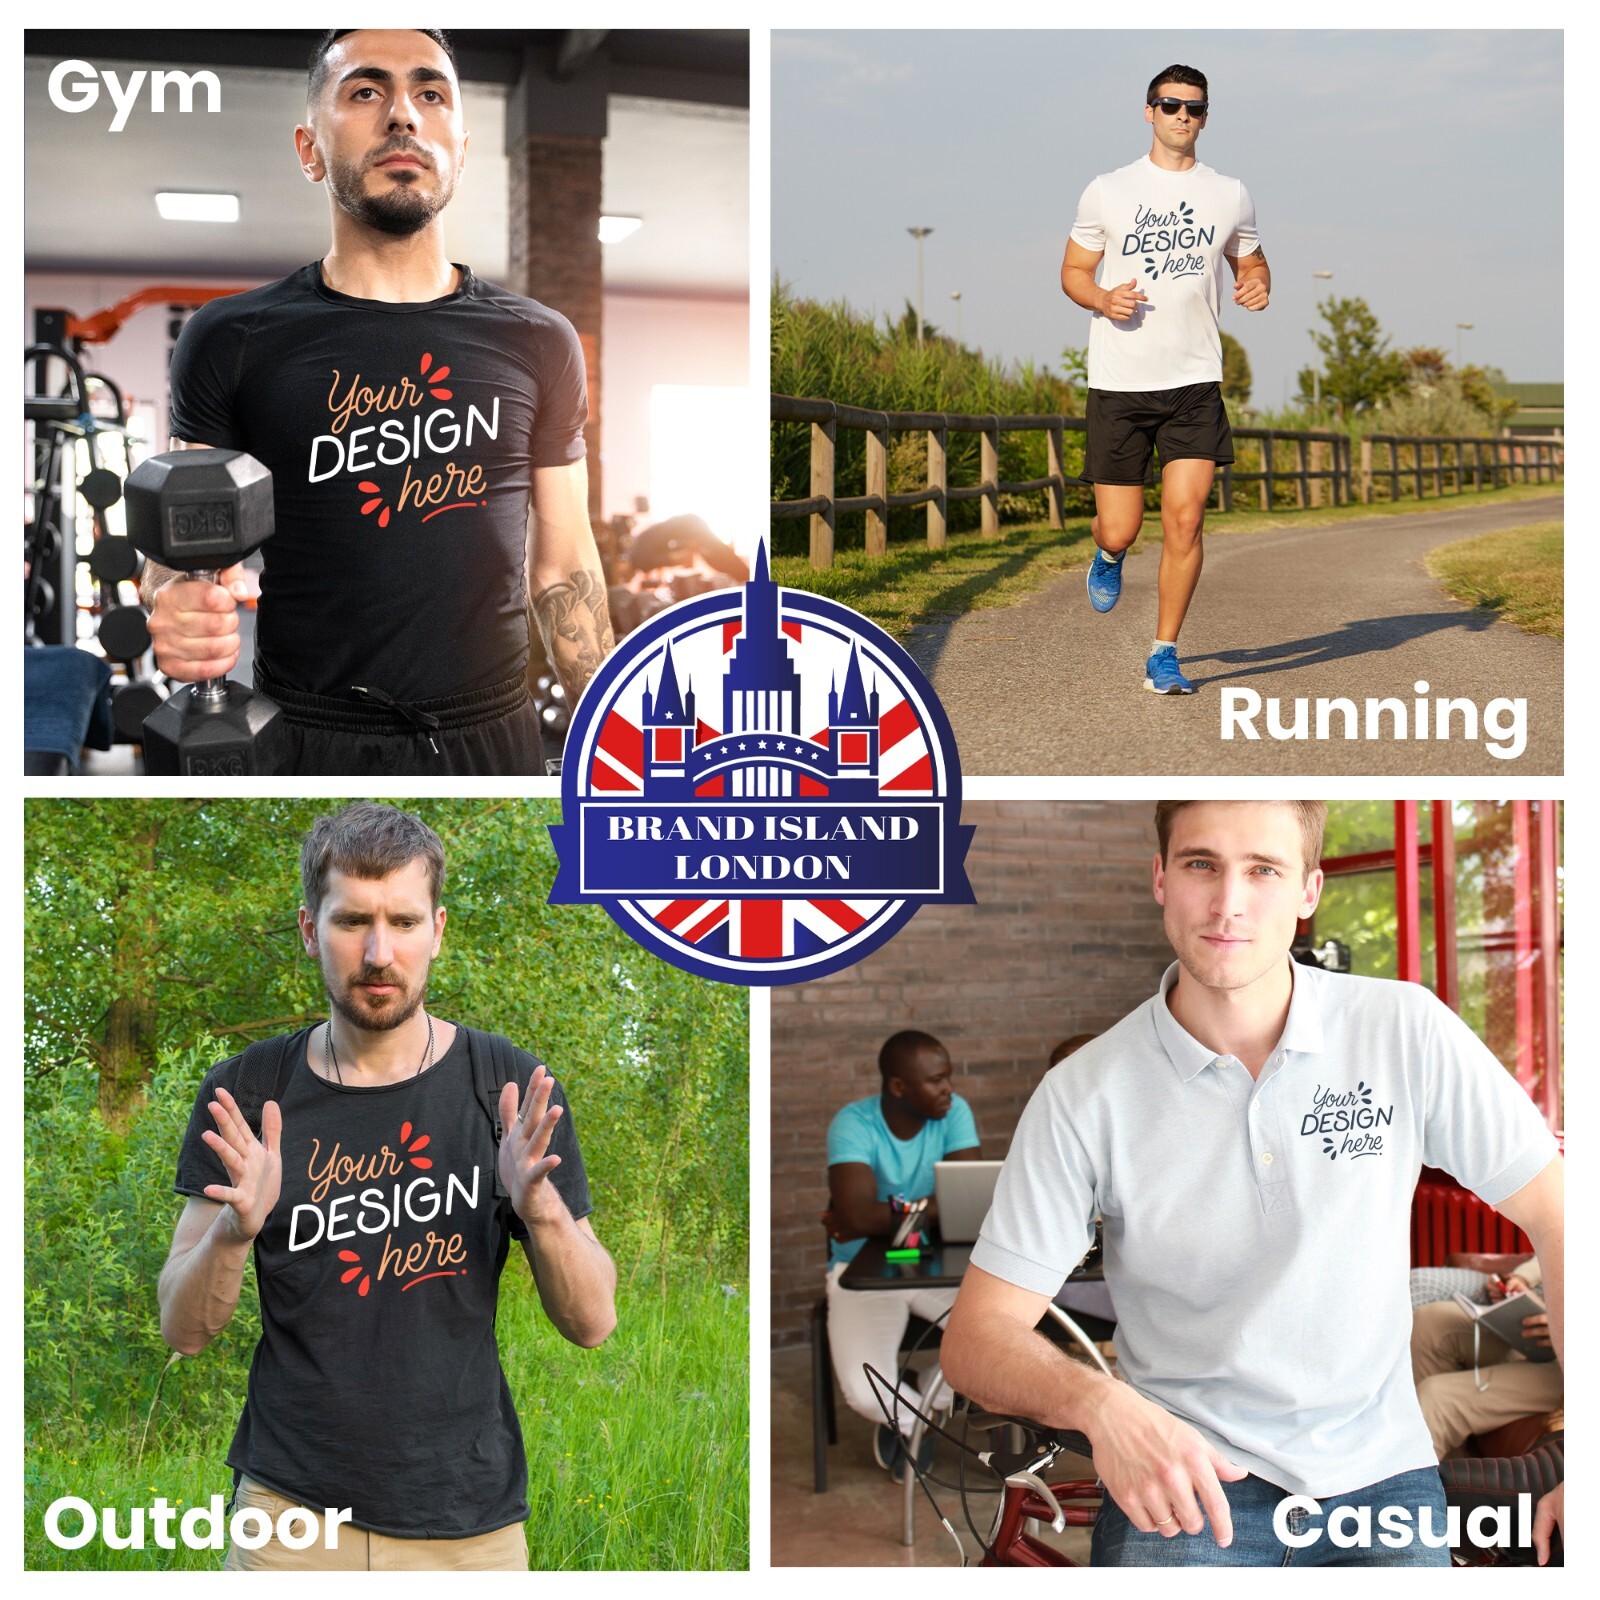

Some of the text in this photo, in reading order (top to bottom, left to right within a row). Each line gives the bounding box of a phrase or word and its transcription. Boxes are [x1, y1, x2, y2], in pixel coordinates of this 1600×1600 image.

[1134, 204, 1180, 234] Your
[1122, 225, 1215, 256] DESIGN
[1162, 252, 1205, 274] here
[328, 369, 424, 434] Your
[308, 396, 500, 483] DESIGN
[397, 462, 487, 512] here
[1313, 1084, 1359, 1114] Your
[1300, 1105, 1393, 1136] DESIGN
[1340, 1132, 1384, 1154] here
[308, 1138, 404, 1203] Your
[288, 1165, 480, 1252] DESIGN
[377, 1231, 467, 1281] here
